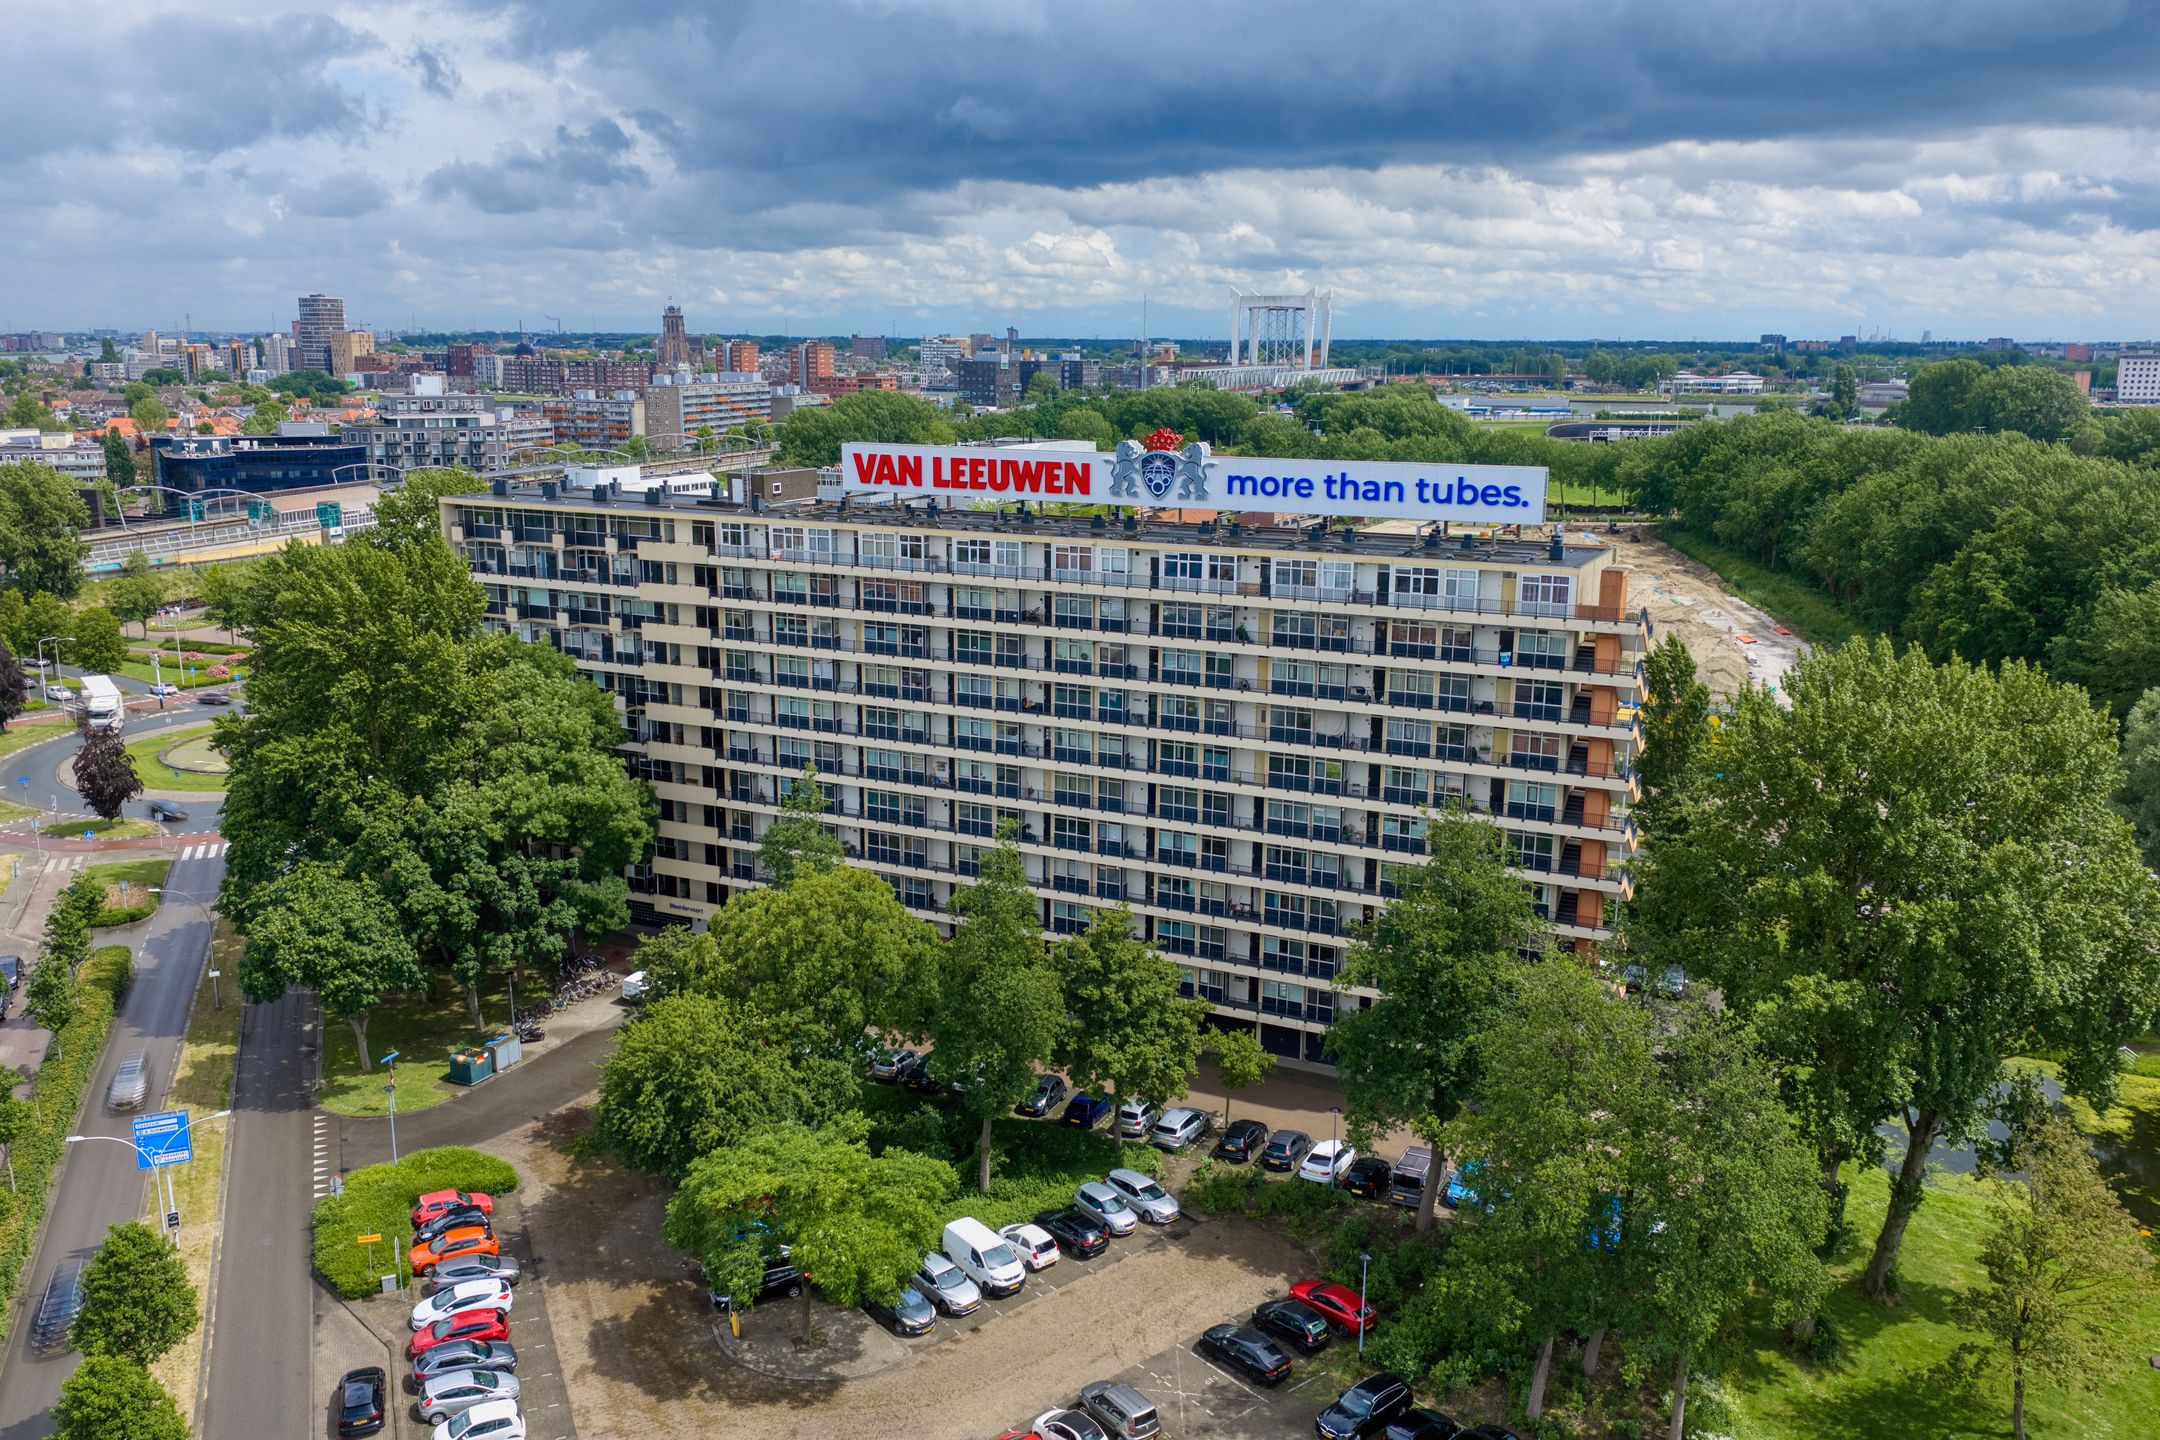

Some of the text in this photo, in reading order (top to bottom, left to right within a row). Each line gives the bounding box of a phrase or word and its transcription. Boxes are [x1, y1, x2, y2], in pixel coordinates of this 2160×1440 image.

[852, 452, 1091, 496] VAN LEEUWEN
[1226, 471, 1530, 508] more than tubes.
